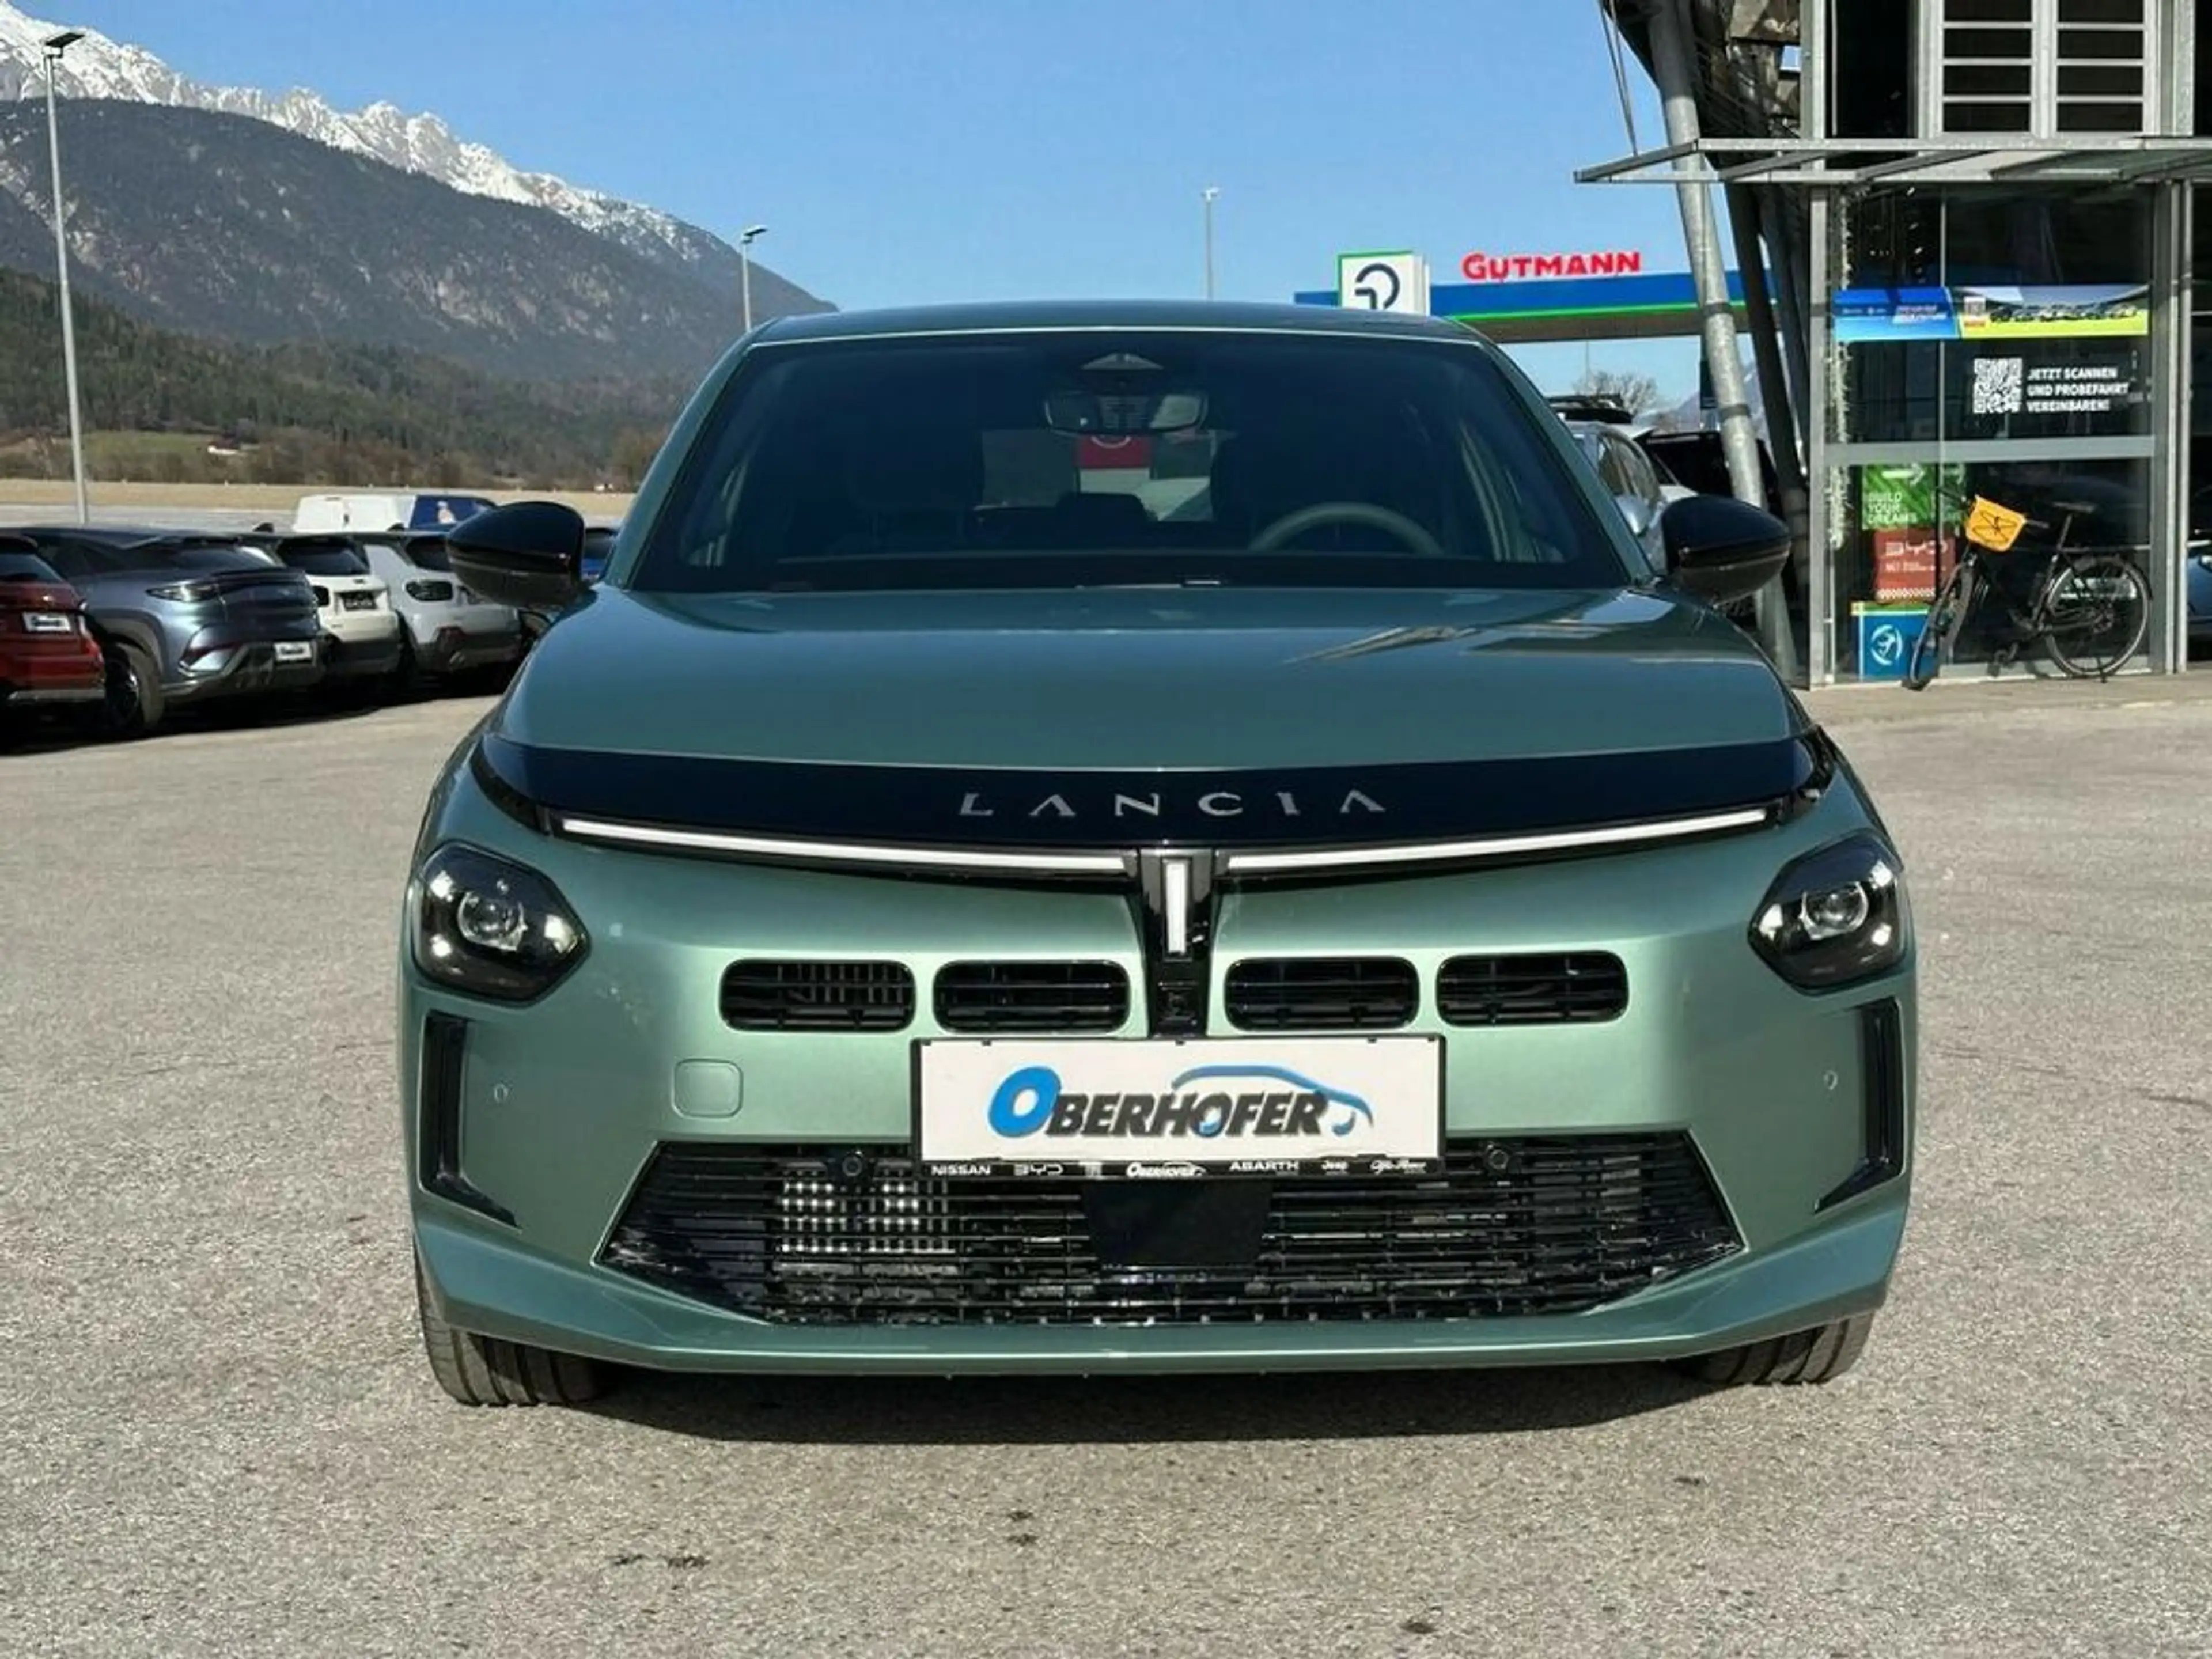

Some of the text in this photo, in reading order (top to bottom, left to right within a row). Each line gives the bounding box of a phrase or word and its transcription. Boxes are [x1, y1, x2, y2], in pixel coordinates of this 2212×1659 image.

[1461, 251, 1641, 281] GUTMANN
[2027, 366, 2118, 381] JETZT SCANNEN
[2027, 382, 2129, 396] UND PROBEFAHRT
[960, 789, 1385, 817] LANCIA
[988, 1066, 1328, 1138] OBERHOFER
[931, 1164, 991, 1176] NISSAN
[1229, 1160, 1300, 1172] ABARTH
